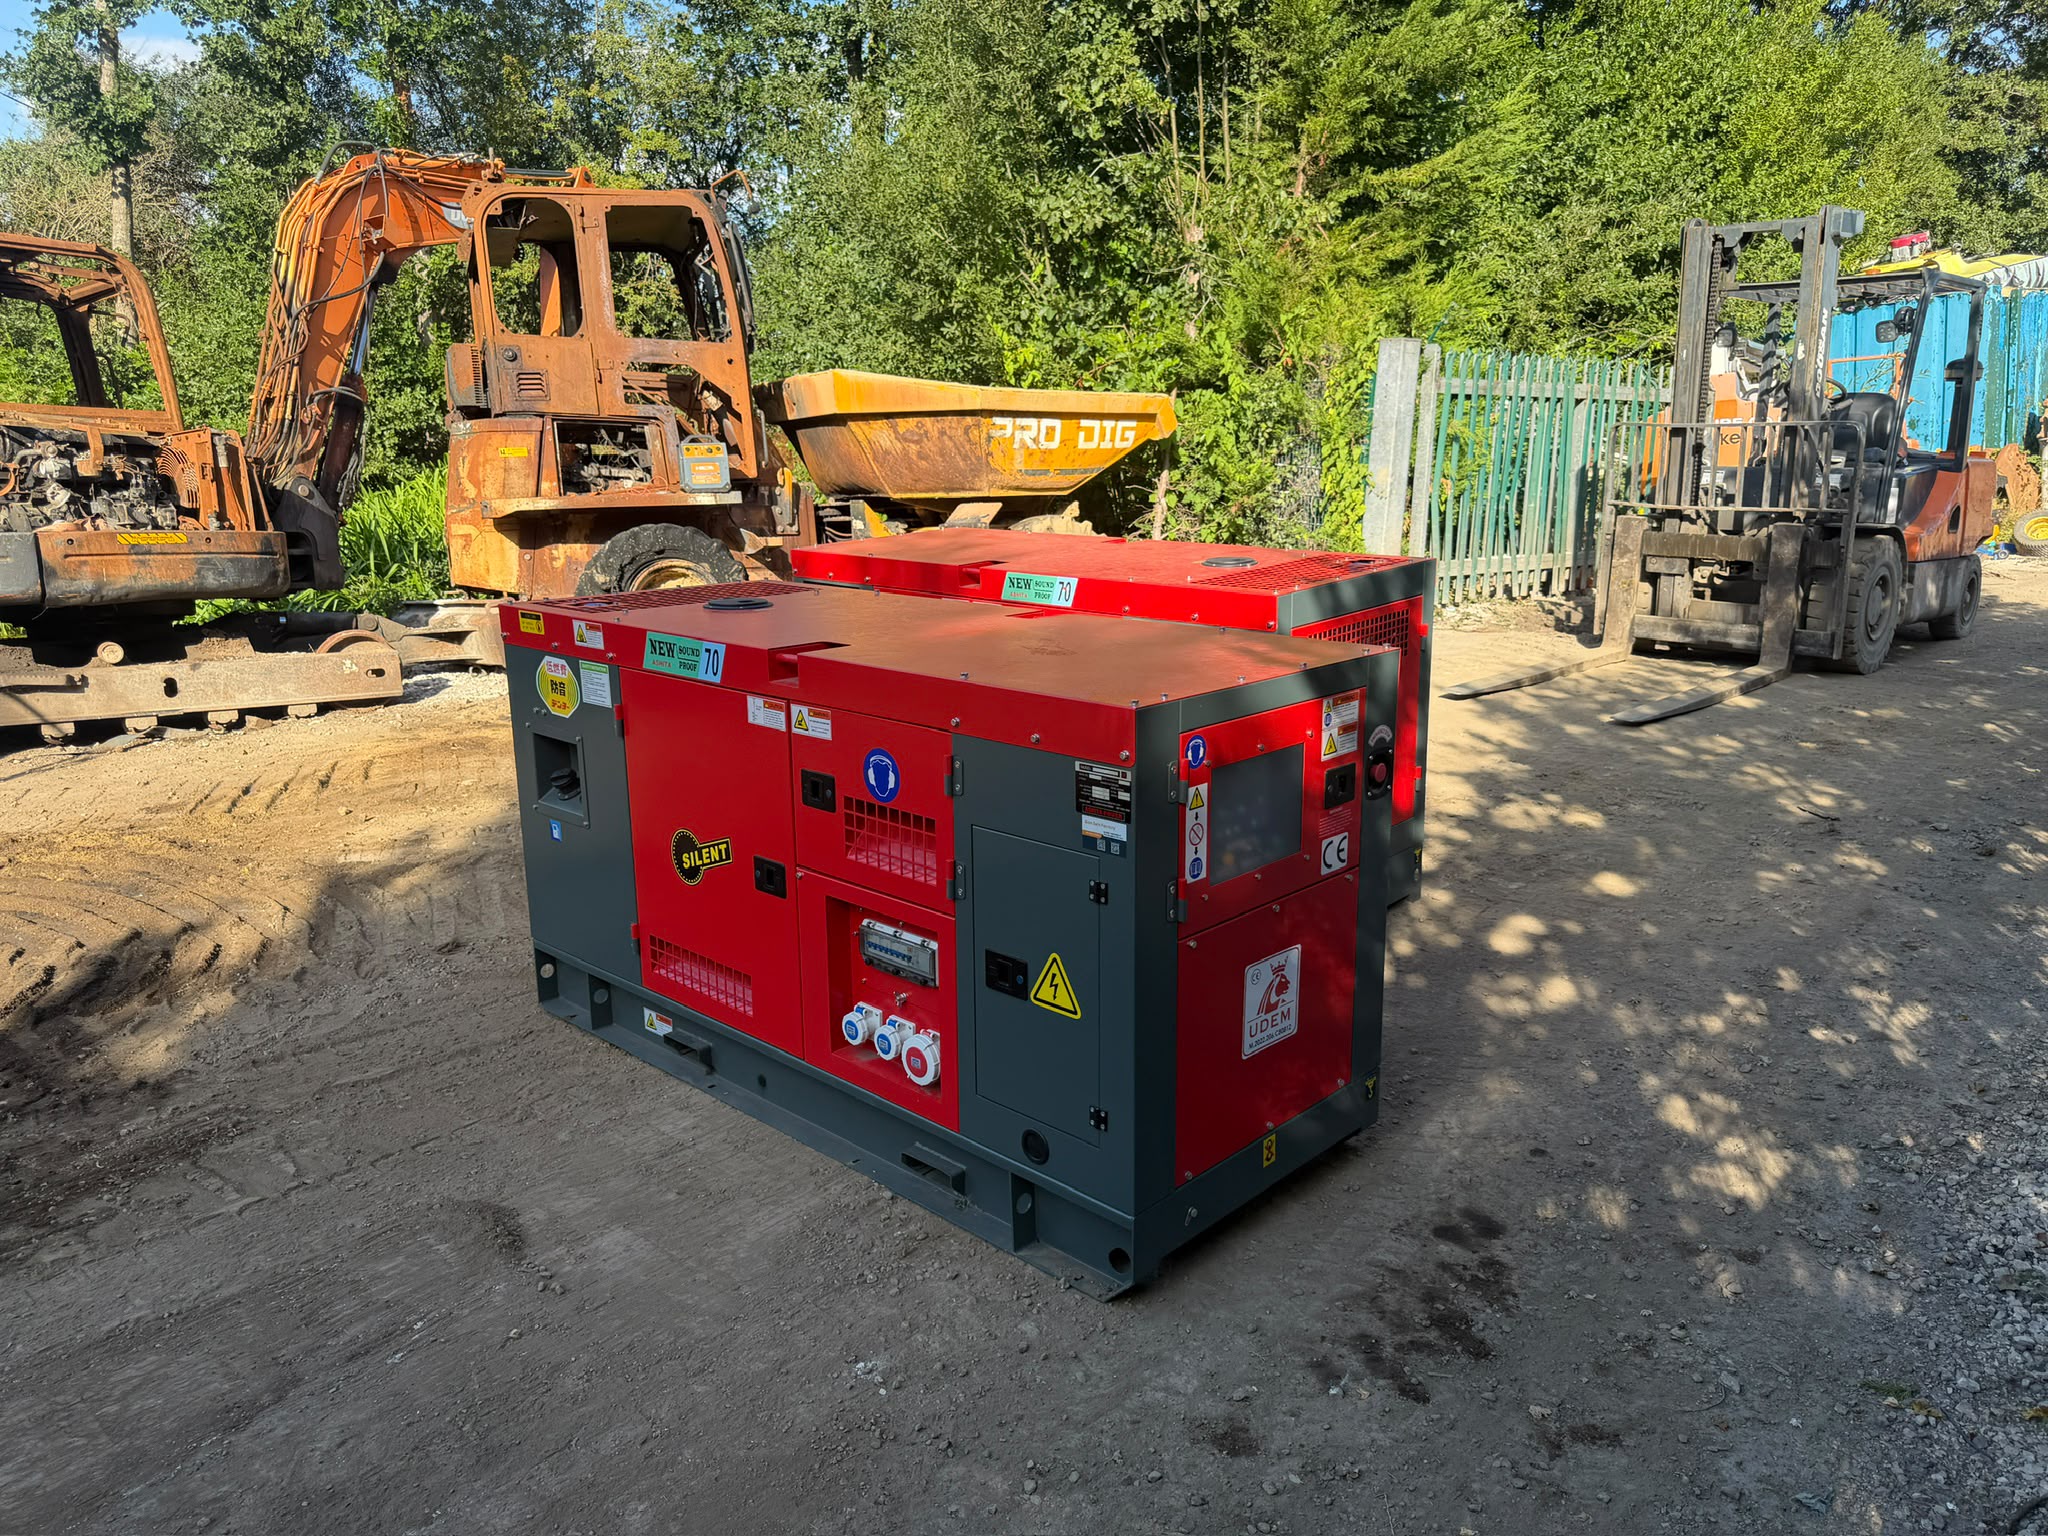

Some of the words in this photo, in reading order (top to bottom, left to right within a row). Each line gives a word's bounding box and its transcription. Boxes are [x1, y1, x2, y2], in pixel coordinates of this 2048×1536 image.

[989, 417, 1062, 449] PRO
[1078, 419, 1137, 449] DIG
[1008, 576, 1033, 590] NEW
[1034, 580, 1055, 589] SOUND
[1057, 581, 1072, 602] 70
[1034, 592, 1051, 600] PROOF
[649, 638, 677, 659] NEW
[678, 645, 700, 658] SOUND
[678, 661, 698, 672] PROOF
[704, 647, 720, 677] 70
[550, 679, 566, 697] 防音
[682, 843, 727, 869] SILENT
[1322, 835, 1348, 869] CE
[1249, 1007, 1291, 1038] UDEM
